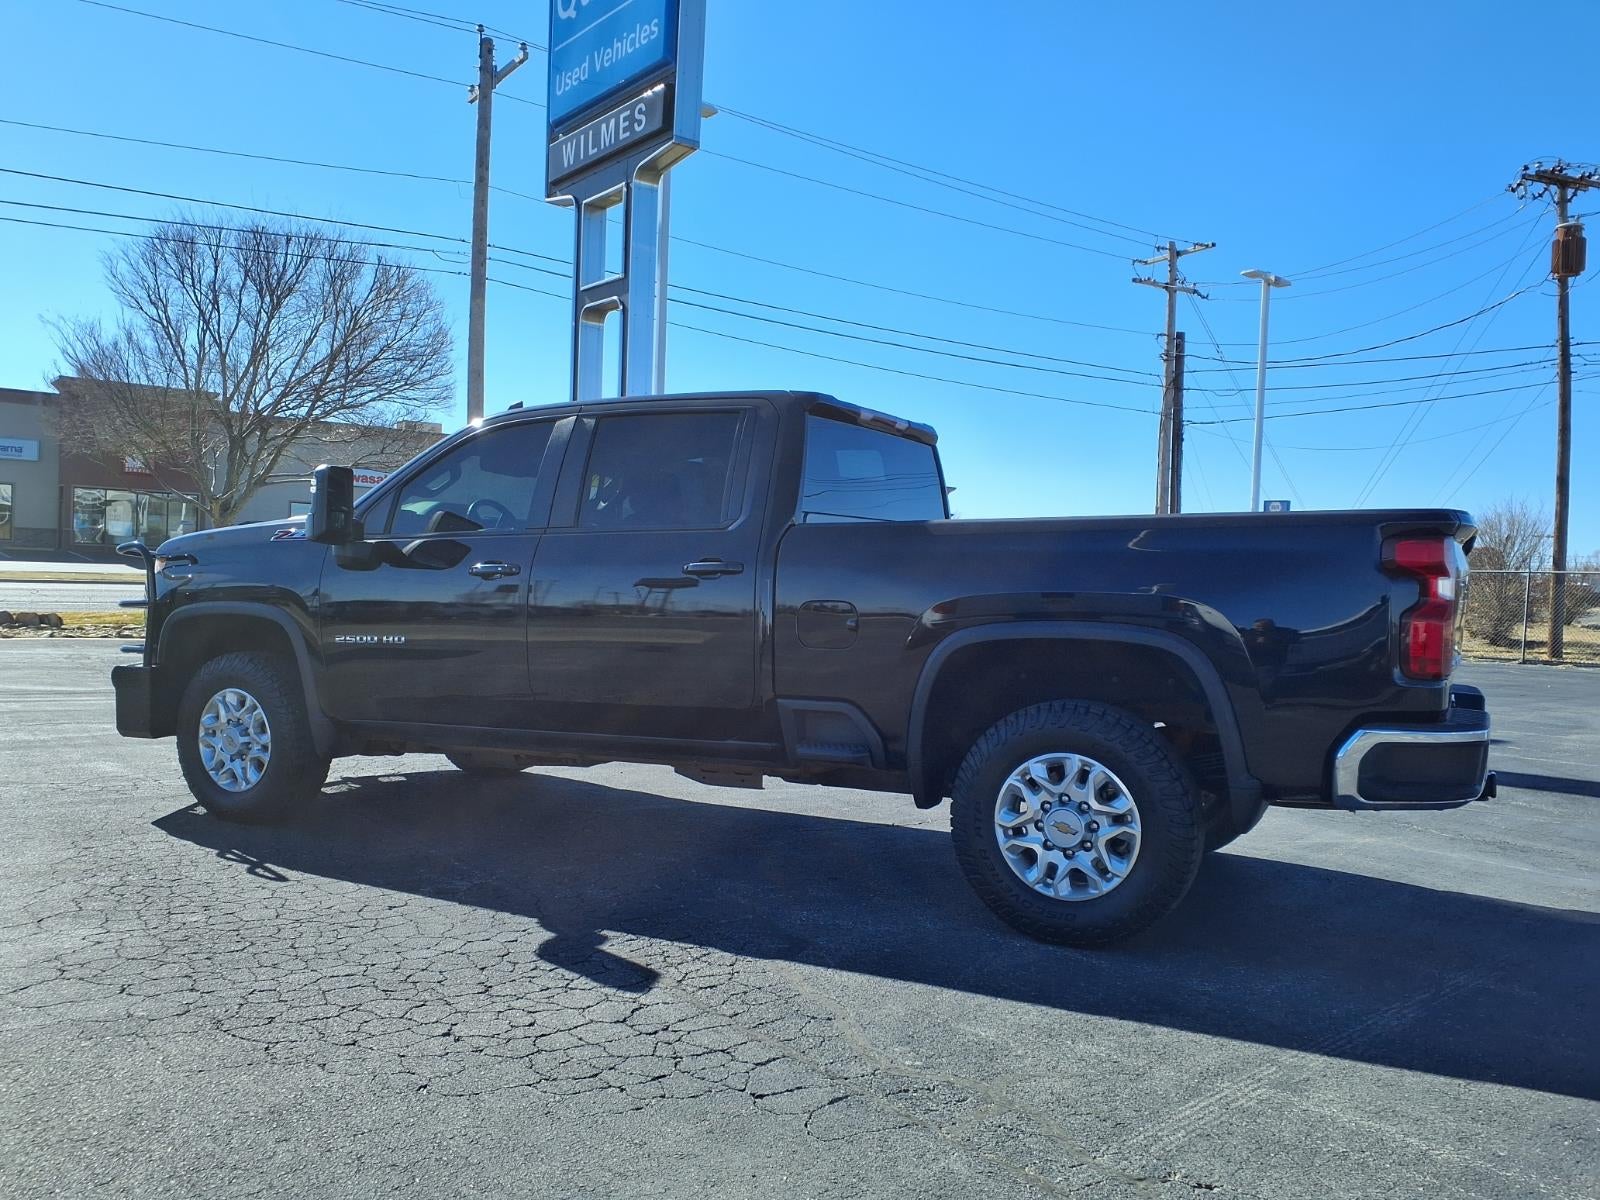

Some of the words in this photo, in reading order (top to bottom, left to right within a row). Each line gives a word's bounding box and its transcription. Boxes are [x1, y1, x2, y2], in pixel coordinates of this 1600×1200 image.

[556, 56, 589, 95] Used
[594, 18, 658, 72] Vehicles
[563, 102, 647, 168] WILMES
[335, 635, 378, 644] 2500
[382, 635, 405, 644] HD
